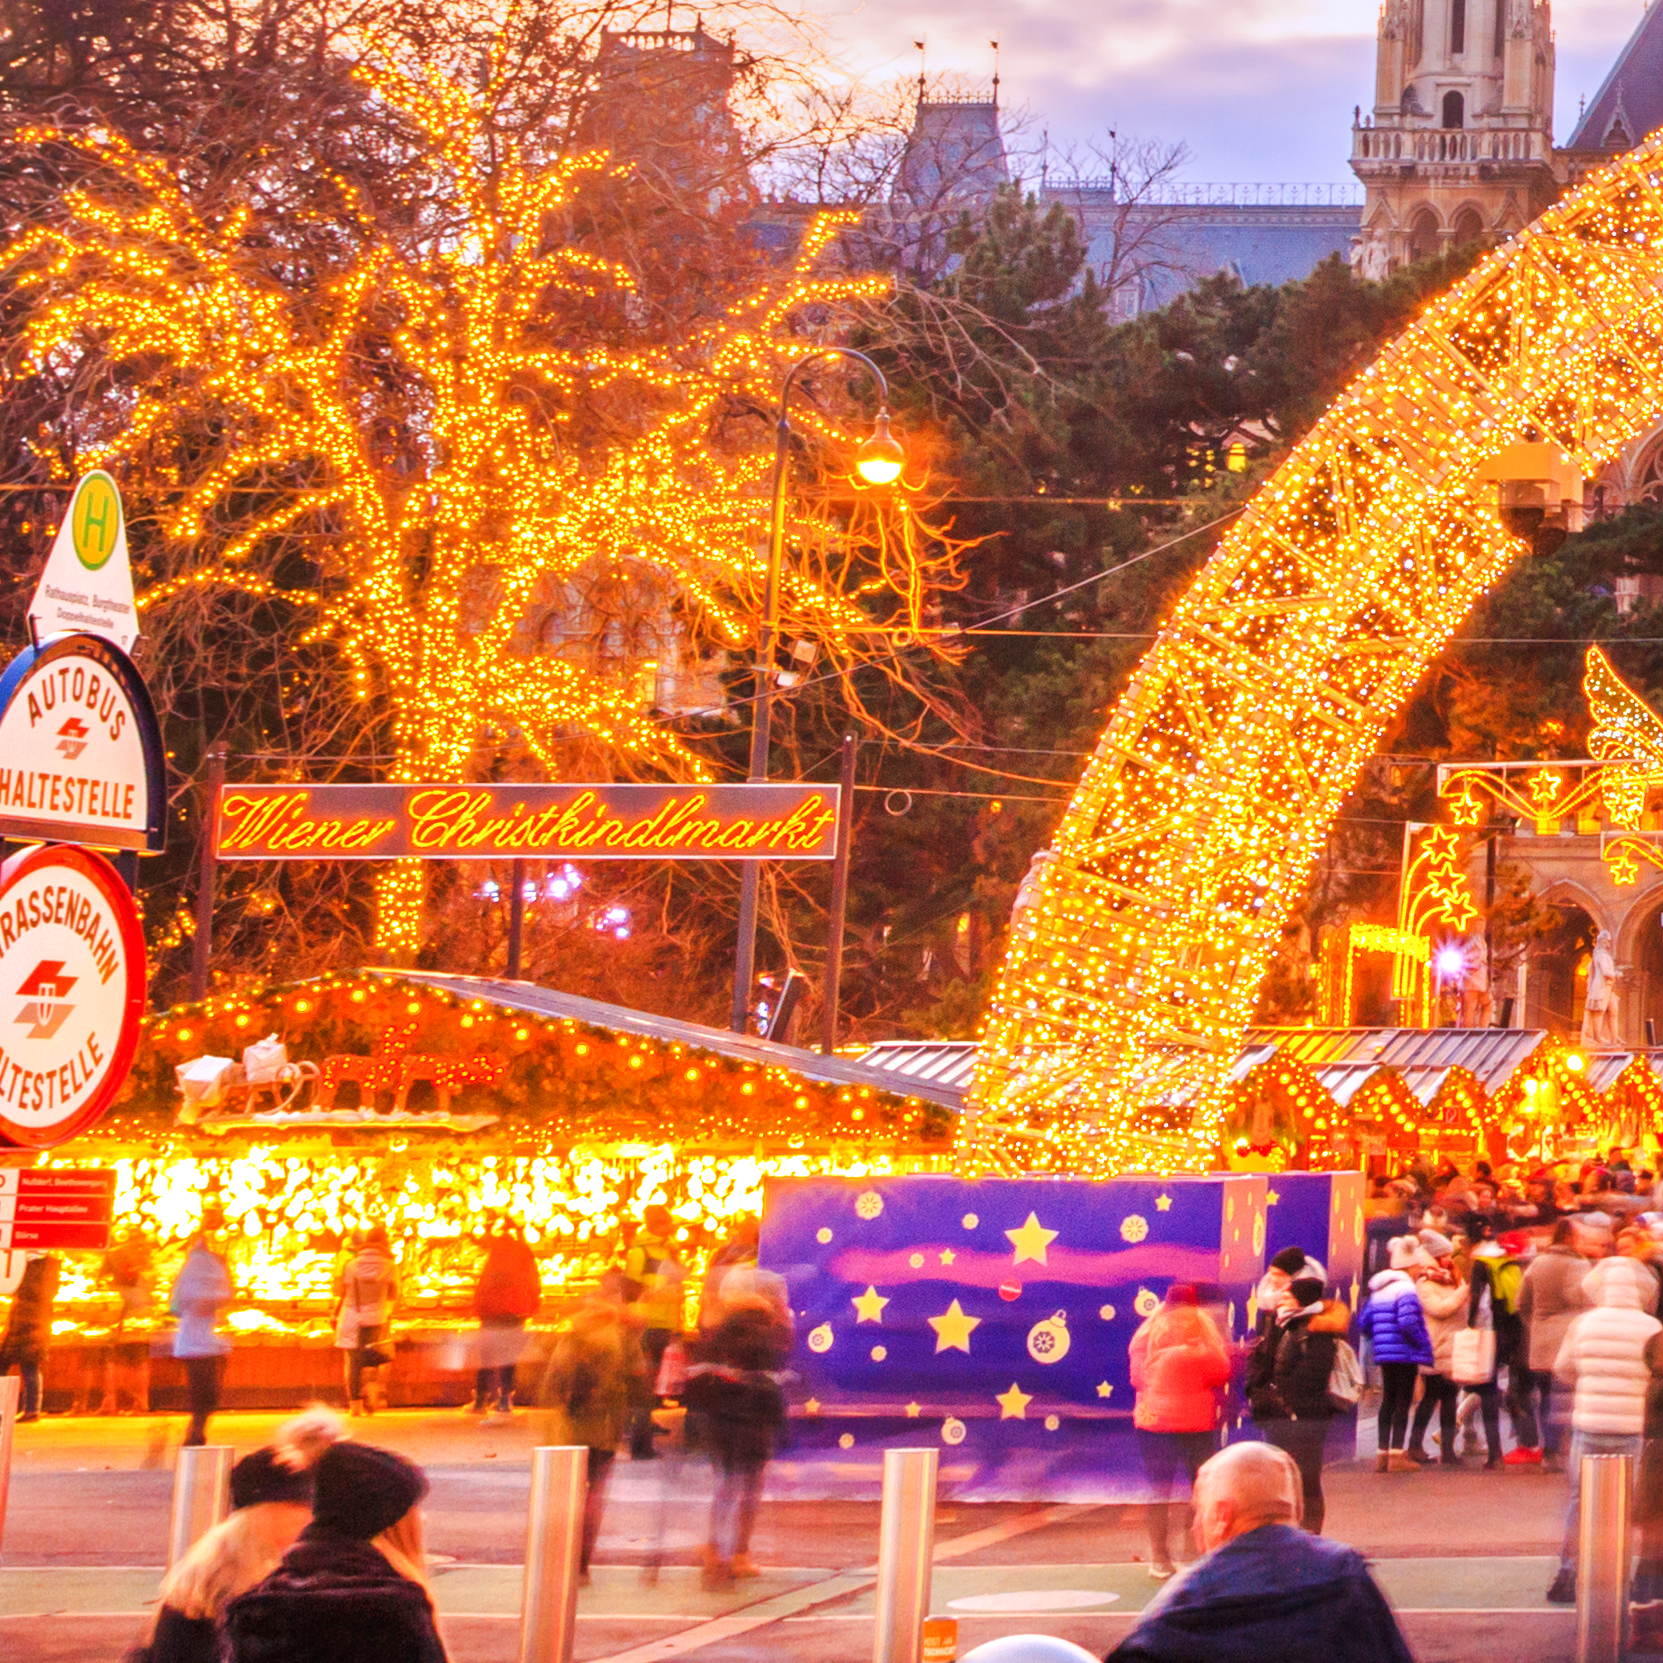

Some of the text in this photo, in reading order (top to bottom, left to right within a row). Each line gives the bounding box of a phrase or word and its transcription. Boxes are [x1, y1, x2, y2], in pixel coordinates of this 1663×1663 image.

[83, 492, 109, 552] H
[27, 667, 126, 741] AUTOBUS
[0, 767, 135, 821] HALTESTELLE
[220, 789, 835, 851] Wiener Christkindlmarkt
[0, 885, 120, 986] RASSENBAHN
[0, 1030, 104, 1112] LTESTELLE
